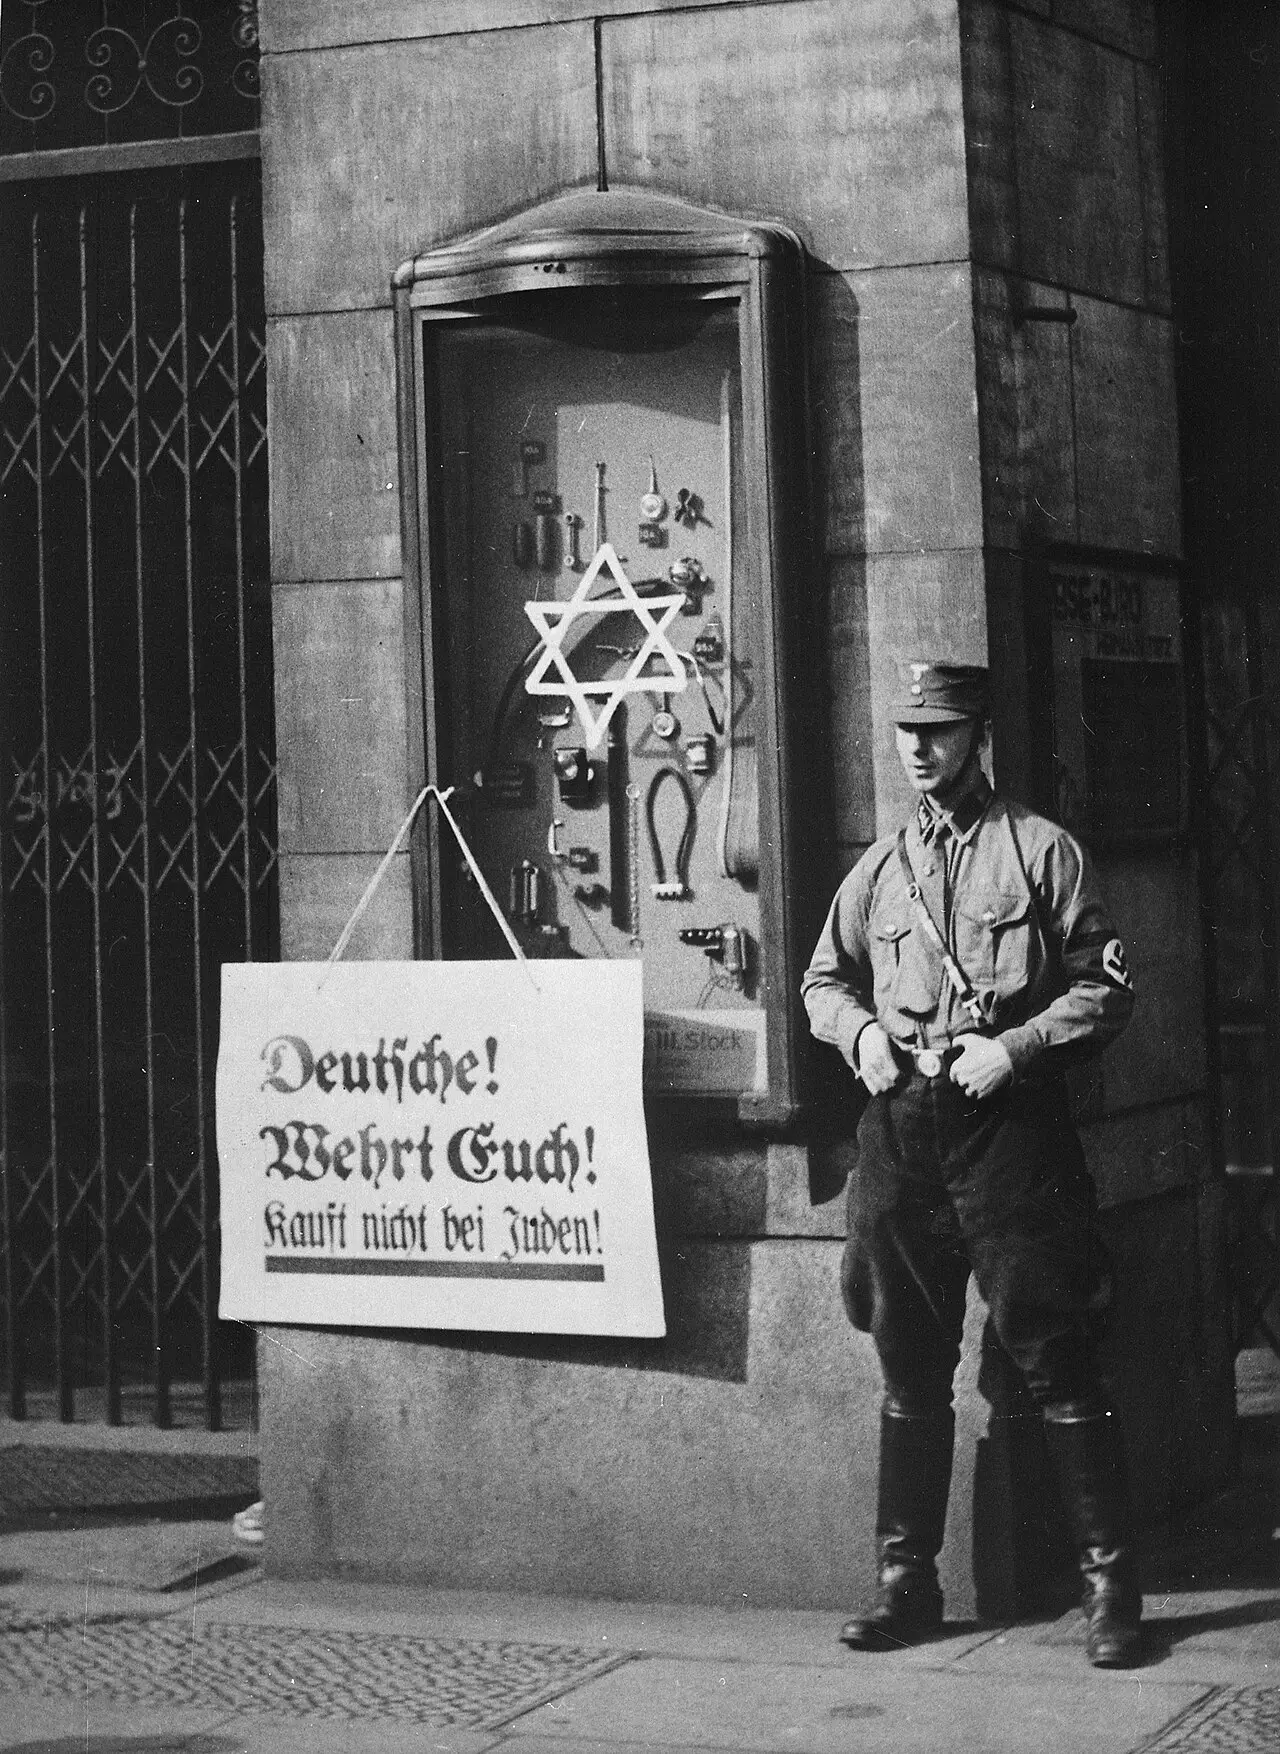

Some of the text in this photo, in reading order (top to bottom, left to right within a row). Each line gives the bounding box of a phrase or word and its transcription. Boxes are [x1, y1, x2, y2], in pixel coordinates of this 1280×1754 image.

[259, 1119, 598, 1193] Wehrt Euch!
[263, 1200, 603, 1262] Kauft nicht bei Juden!
